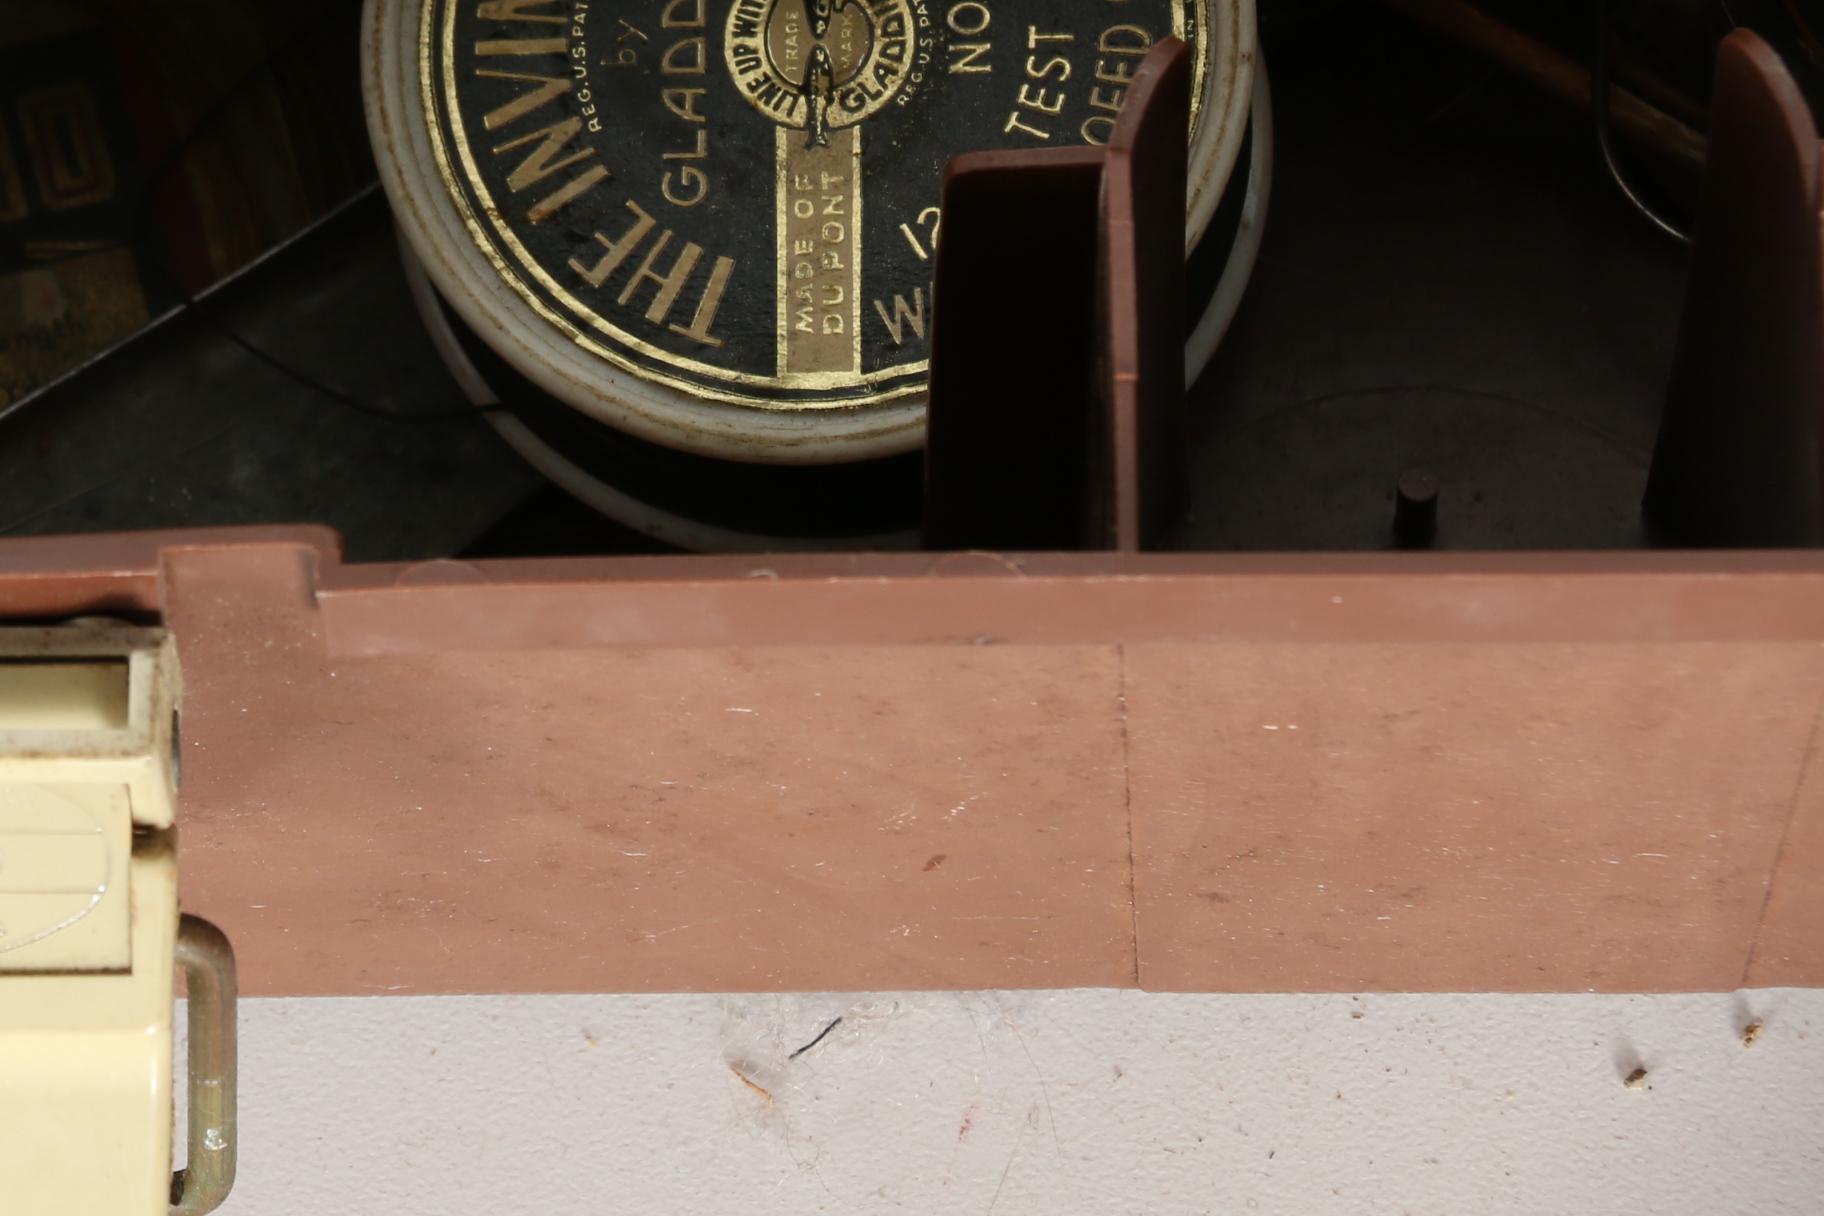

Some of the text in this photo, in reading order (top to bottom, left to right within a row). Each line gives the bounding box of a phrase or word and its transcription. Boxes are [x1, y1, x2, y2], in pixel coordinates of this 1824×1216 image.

[600, 18, 649, 67] by
[733, 43, 764, 75] UP
[785, 10, 800, 72] TRADE
[946, 0, 992, 75] NO
[746, 71, 802, 118] LINE
[1003, 25, 1074, 139] TEST
[568, 200, 736, 347] THE
[794, 173, 815, 334] MADE OF
